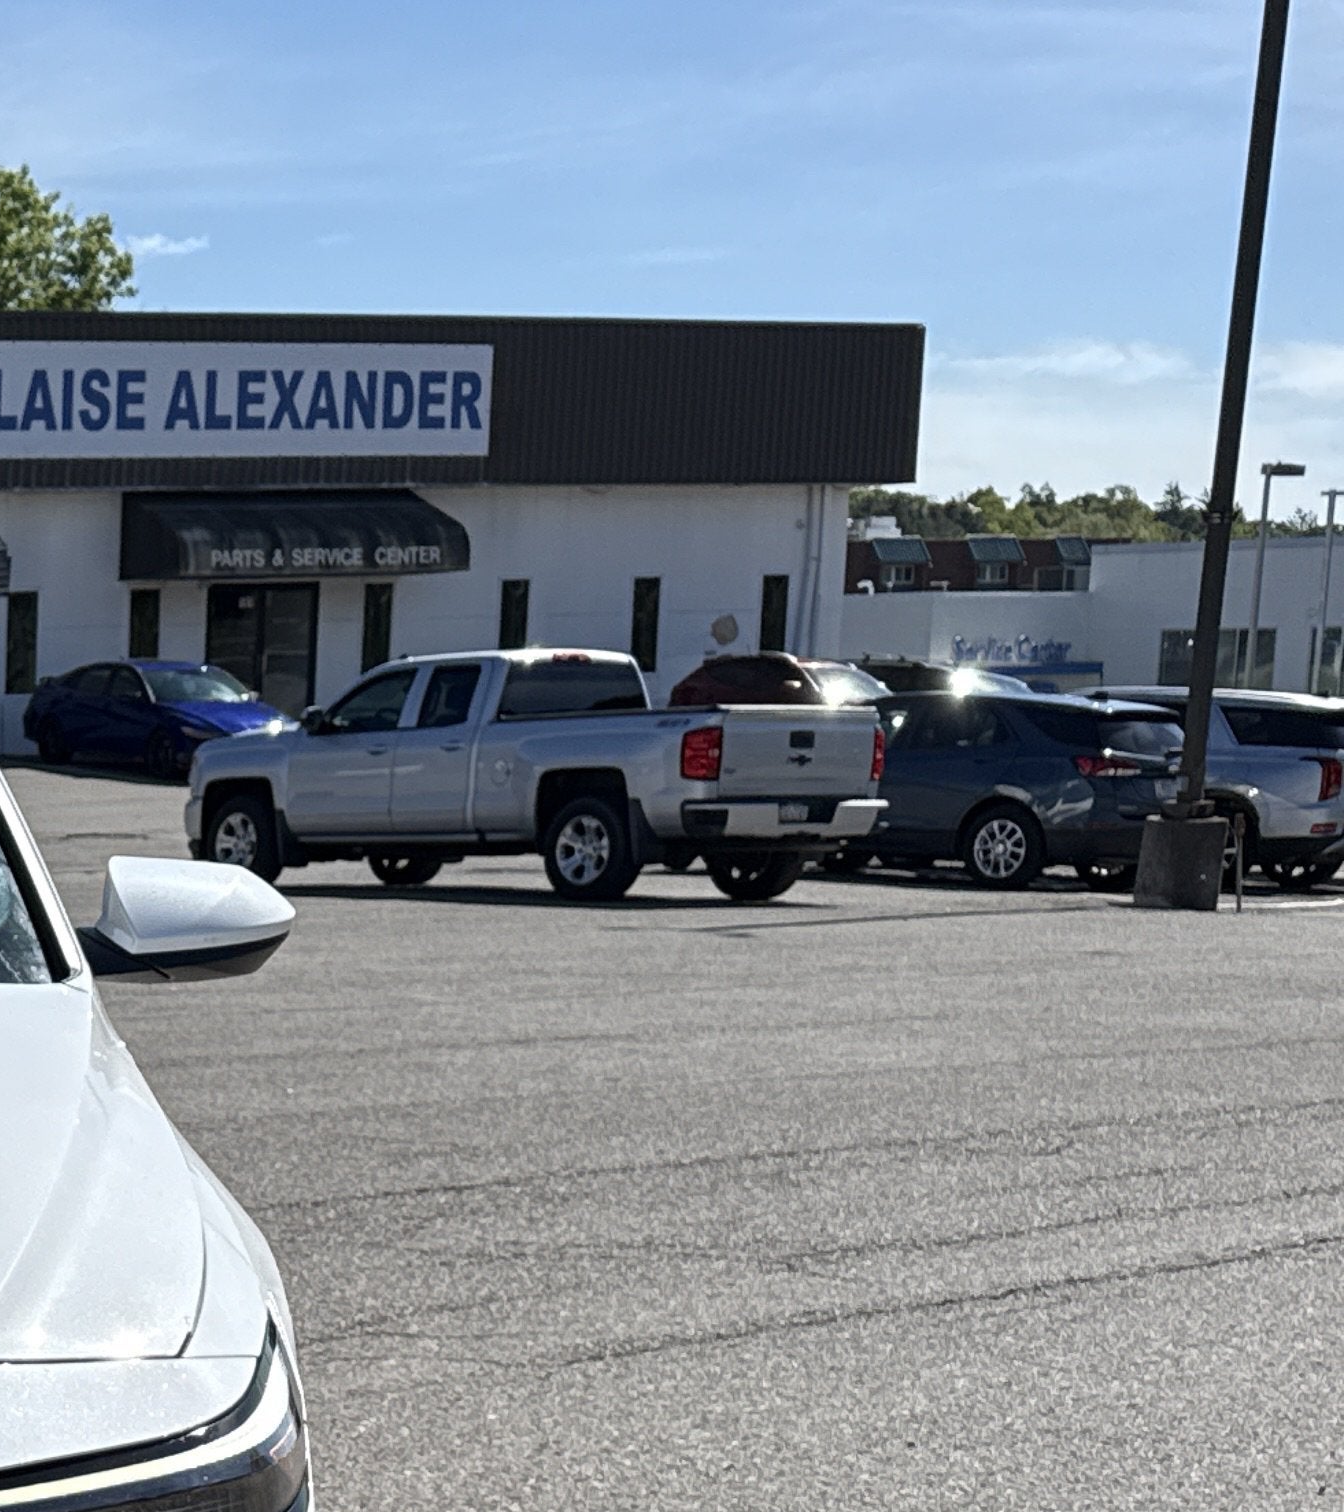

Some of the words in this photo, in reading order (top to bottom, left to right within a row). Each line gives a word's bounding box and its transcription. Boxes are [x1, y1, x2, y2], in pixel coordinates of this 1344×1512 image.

[163, 368, 484, 431] ALEXANDER
[211, 548, 265, 568] PARTS
[271, 549, 284, 567] &
[291, 547, 363, 567] SERVICE
[374, 545, 442, 565] CENTER
